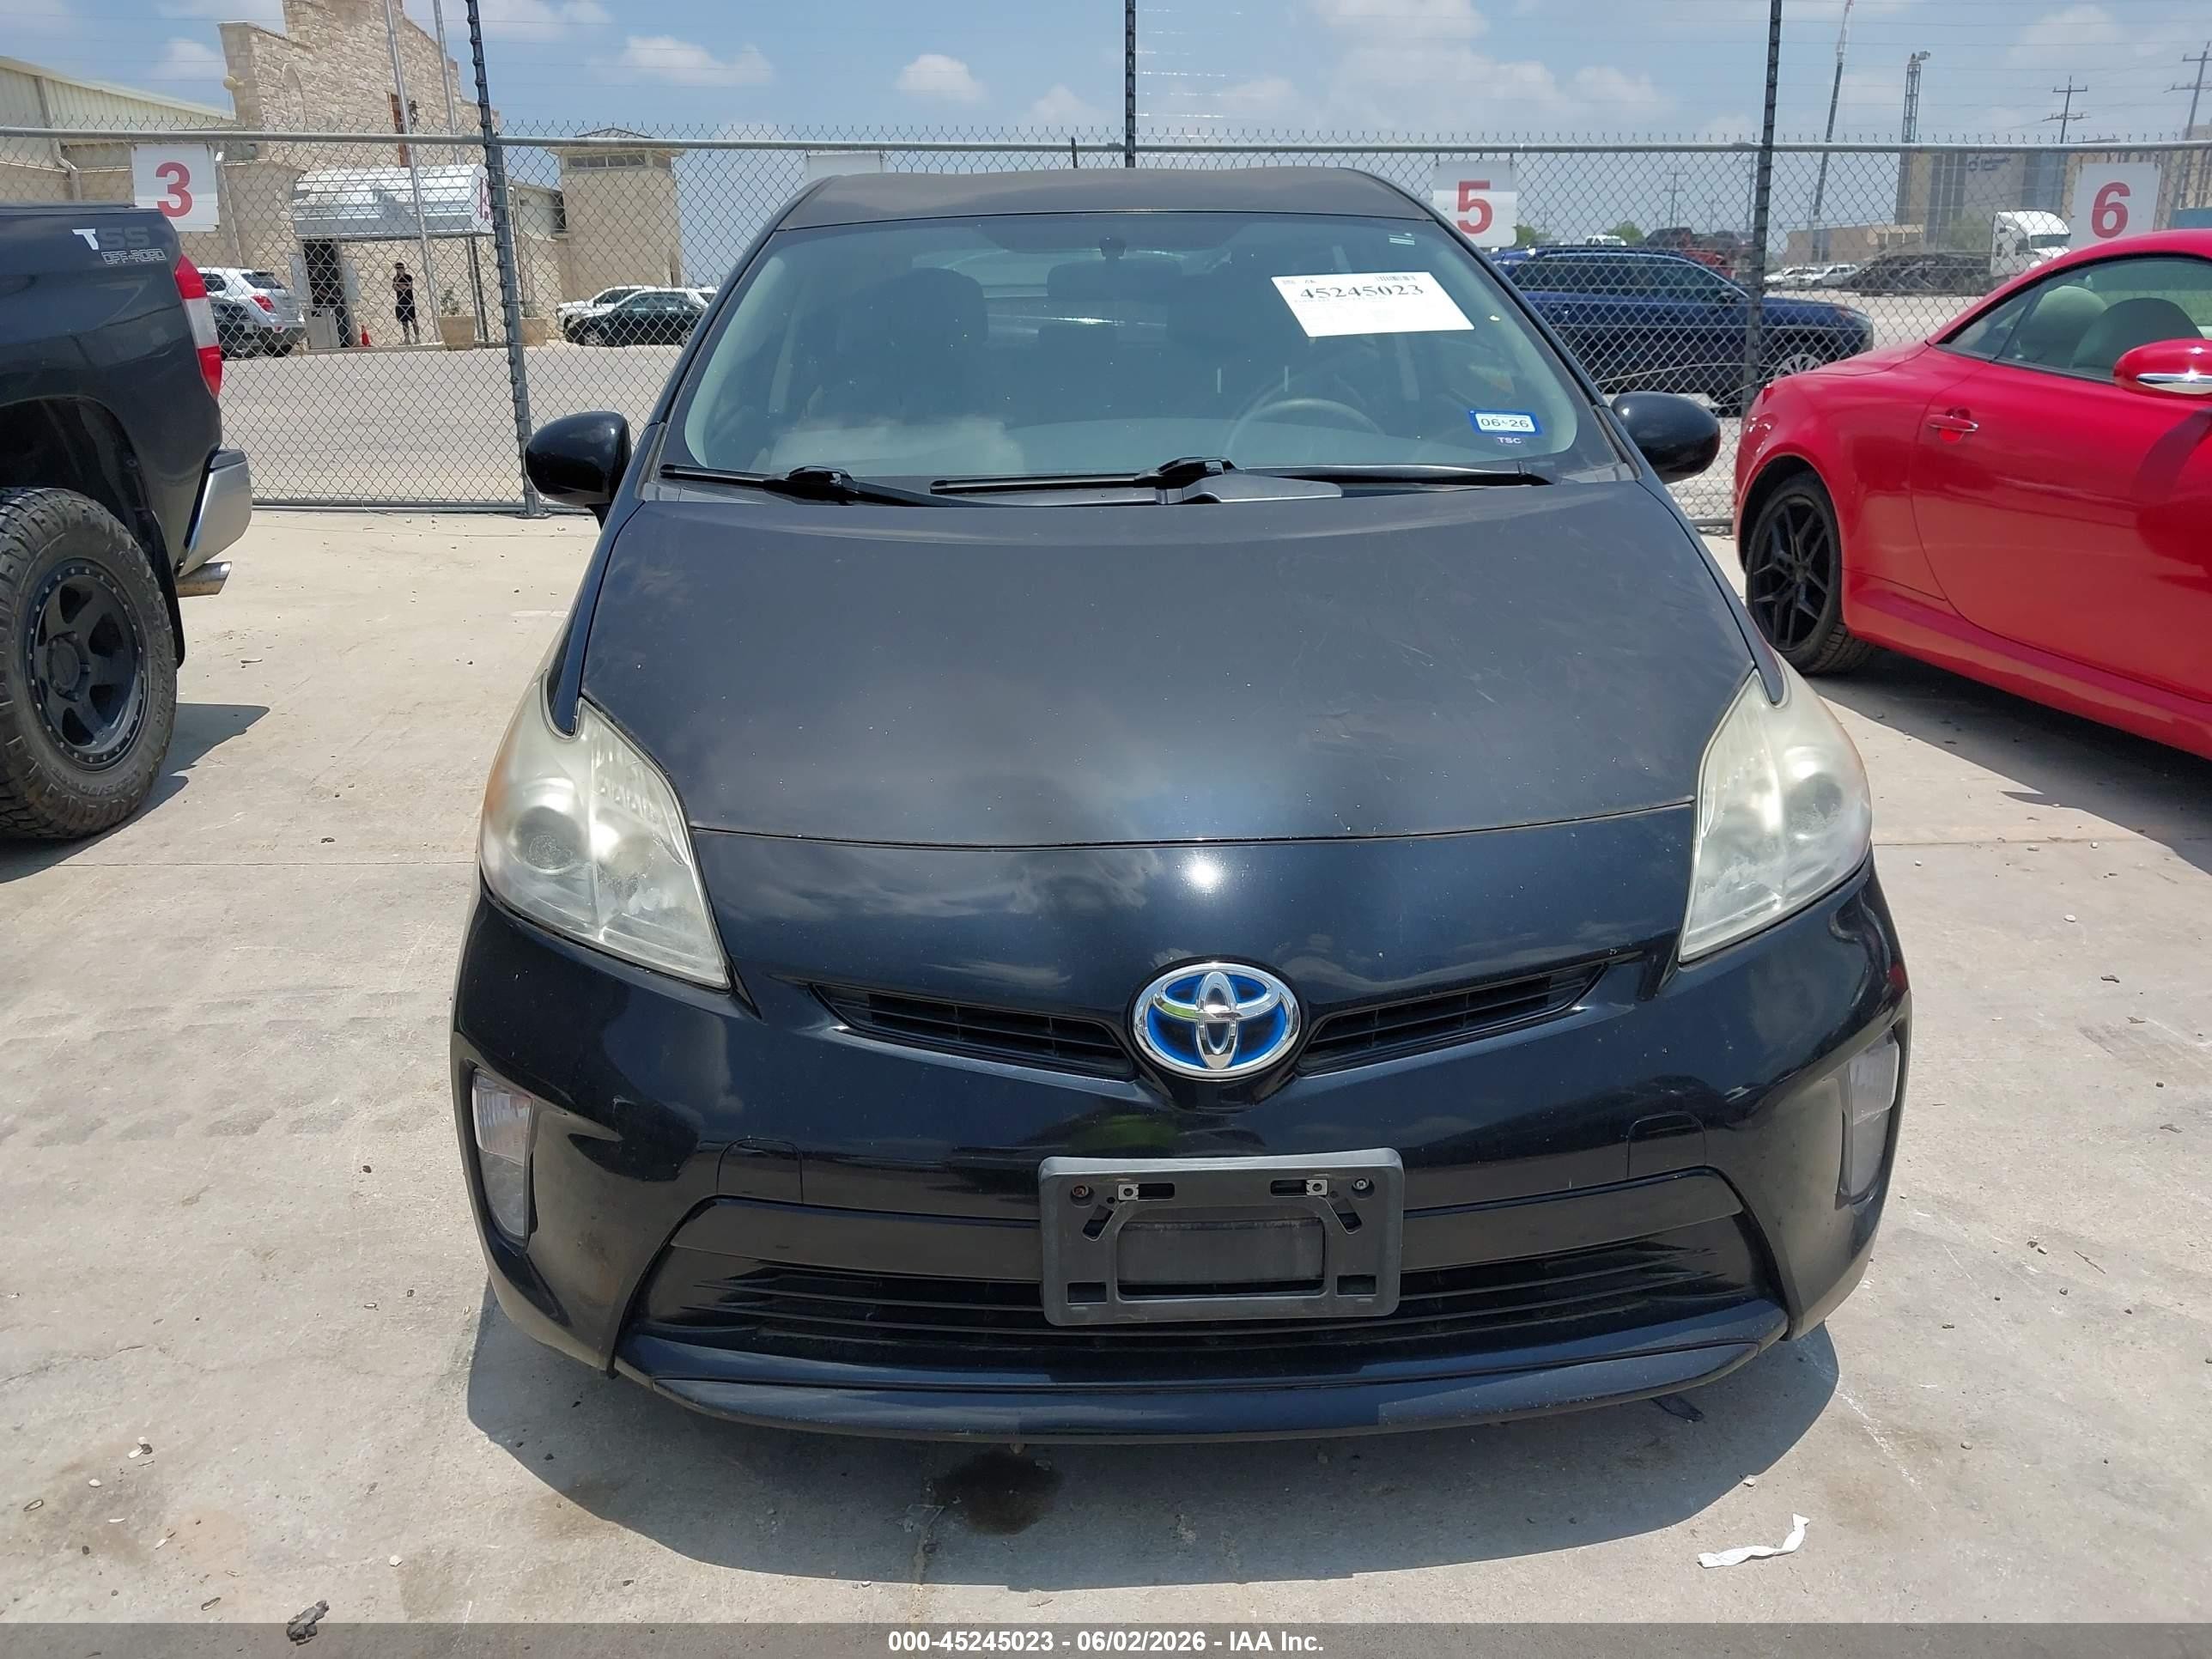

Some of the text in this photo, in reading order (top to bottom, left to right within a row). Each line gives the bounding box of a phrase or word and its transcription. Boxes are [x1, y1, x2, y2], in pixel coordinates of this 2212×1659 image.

[155, 161, 192, 217] 3
[1457, 180, 1492, 234] 5
[2092, 181, 2130, 239] 6
[1300, 284, 1423, 299] 45245023
